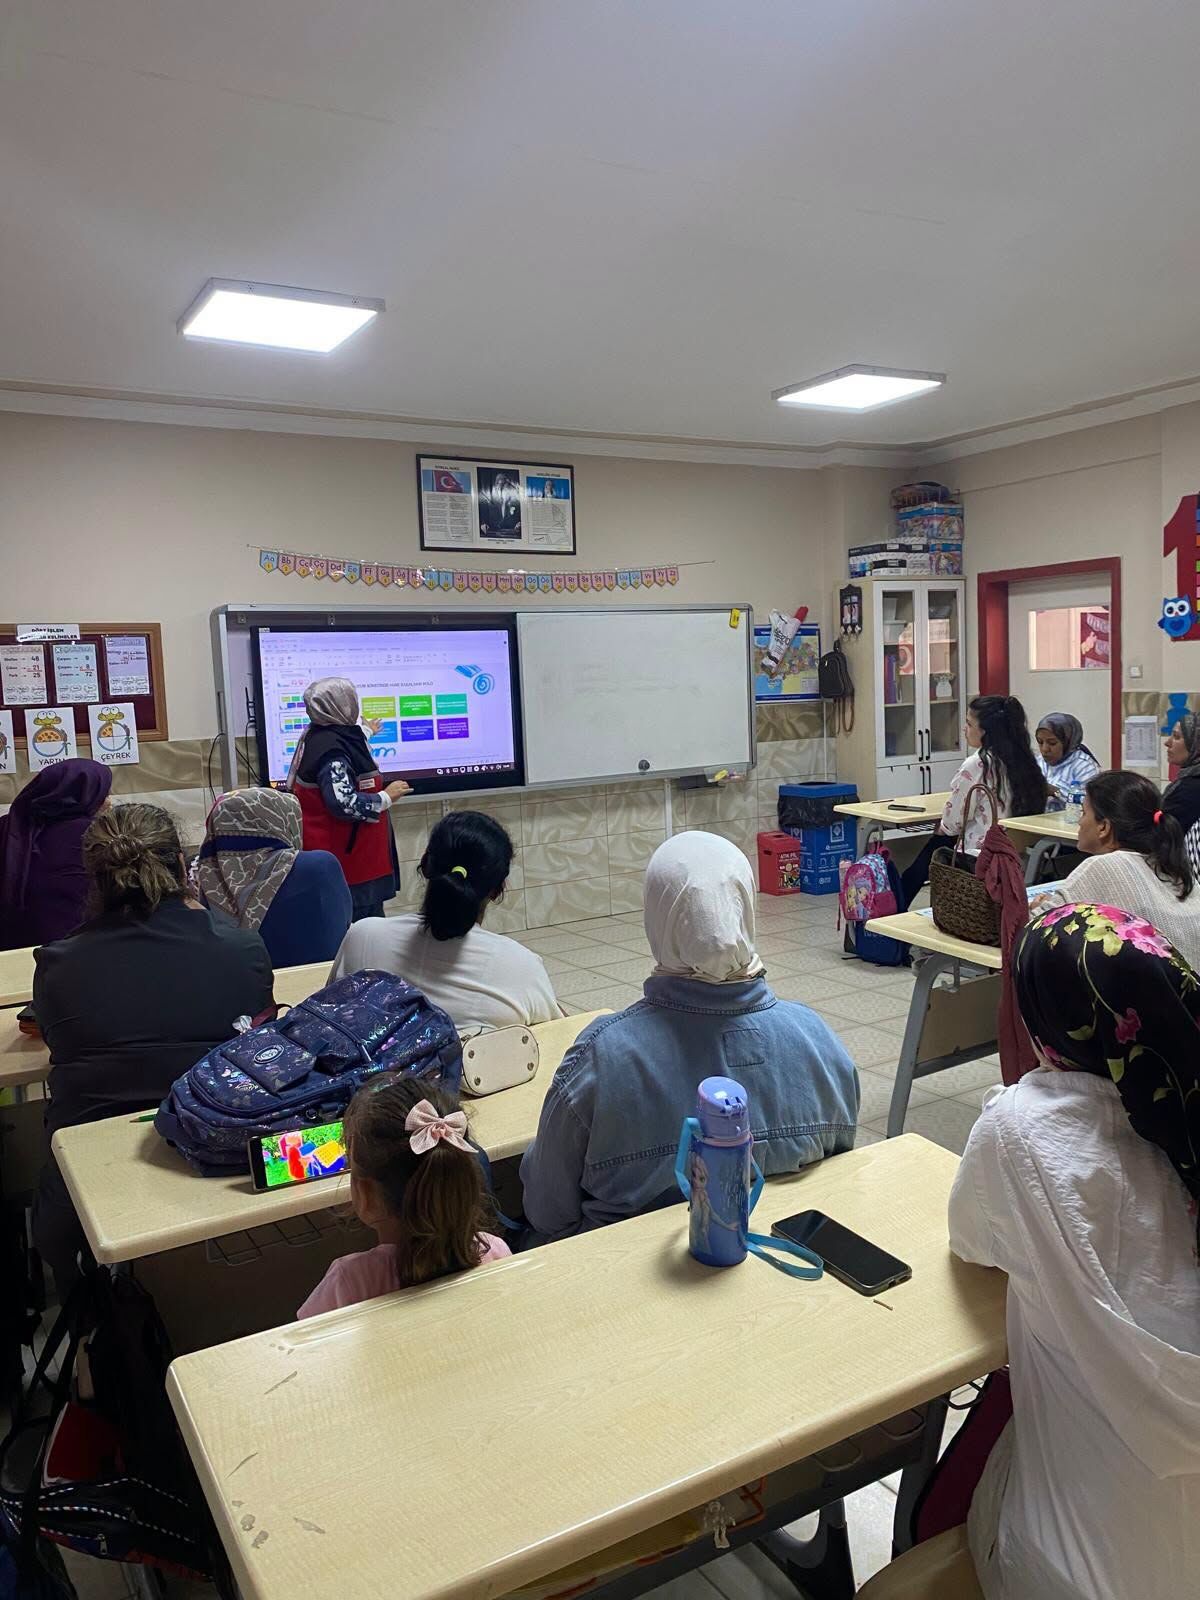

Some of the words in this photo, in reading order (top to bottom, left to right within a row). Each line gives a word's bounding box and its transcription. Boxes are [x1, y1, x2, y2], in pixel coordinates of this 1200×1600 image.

[281, 557, 291, 565] Bb
[330, 563, 341, 571] Dd
[101, 752, 131, 762] ÇEYREK
